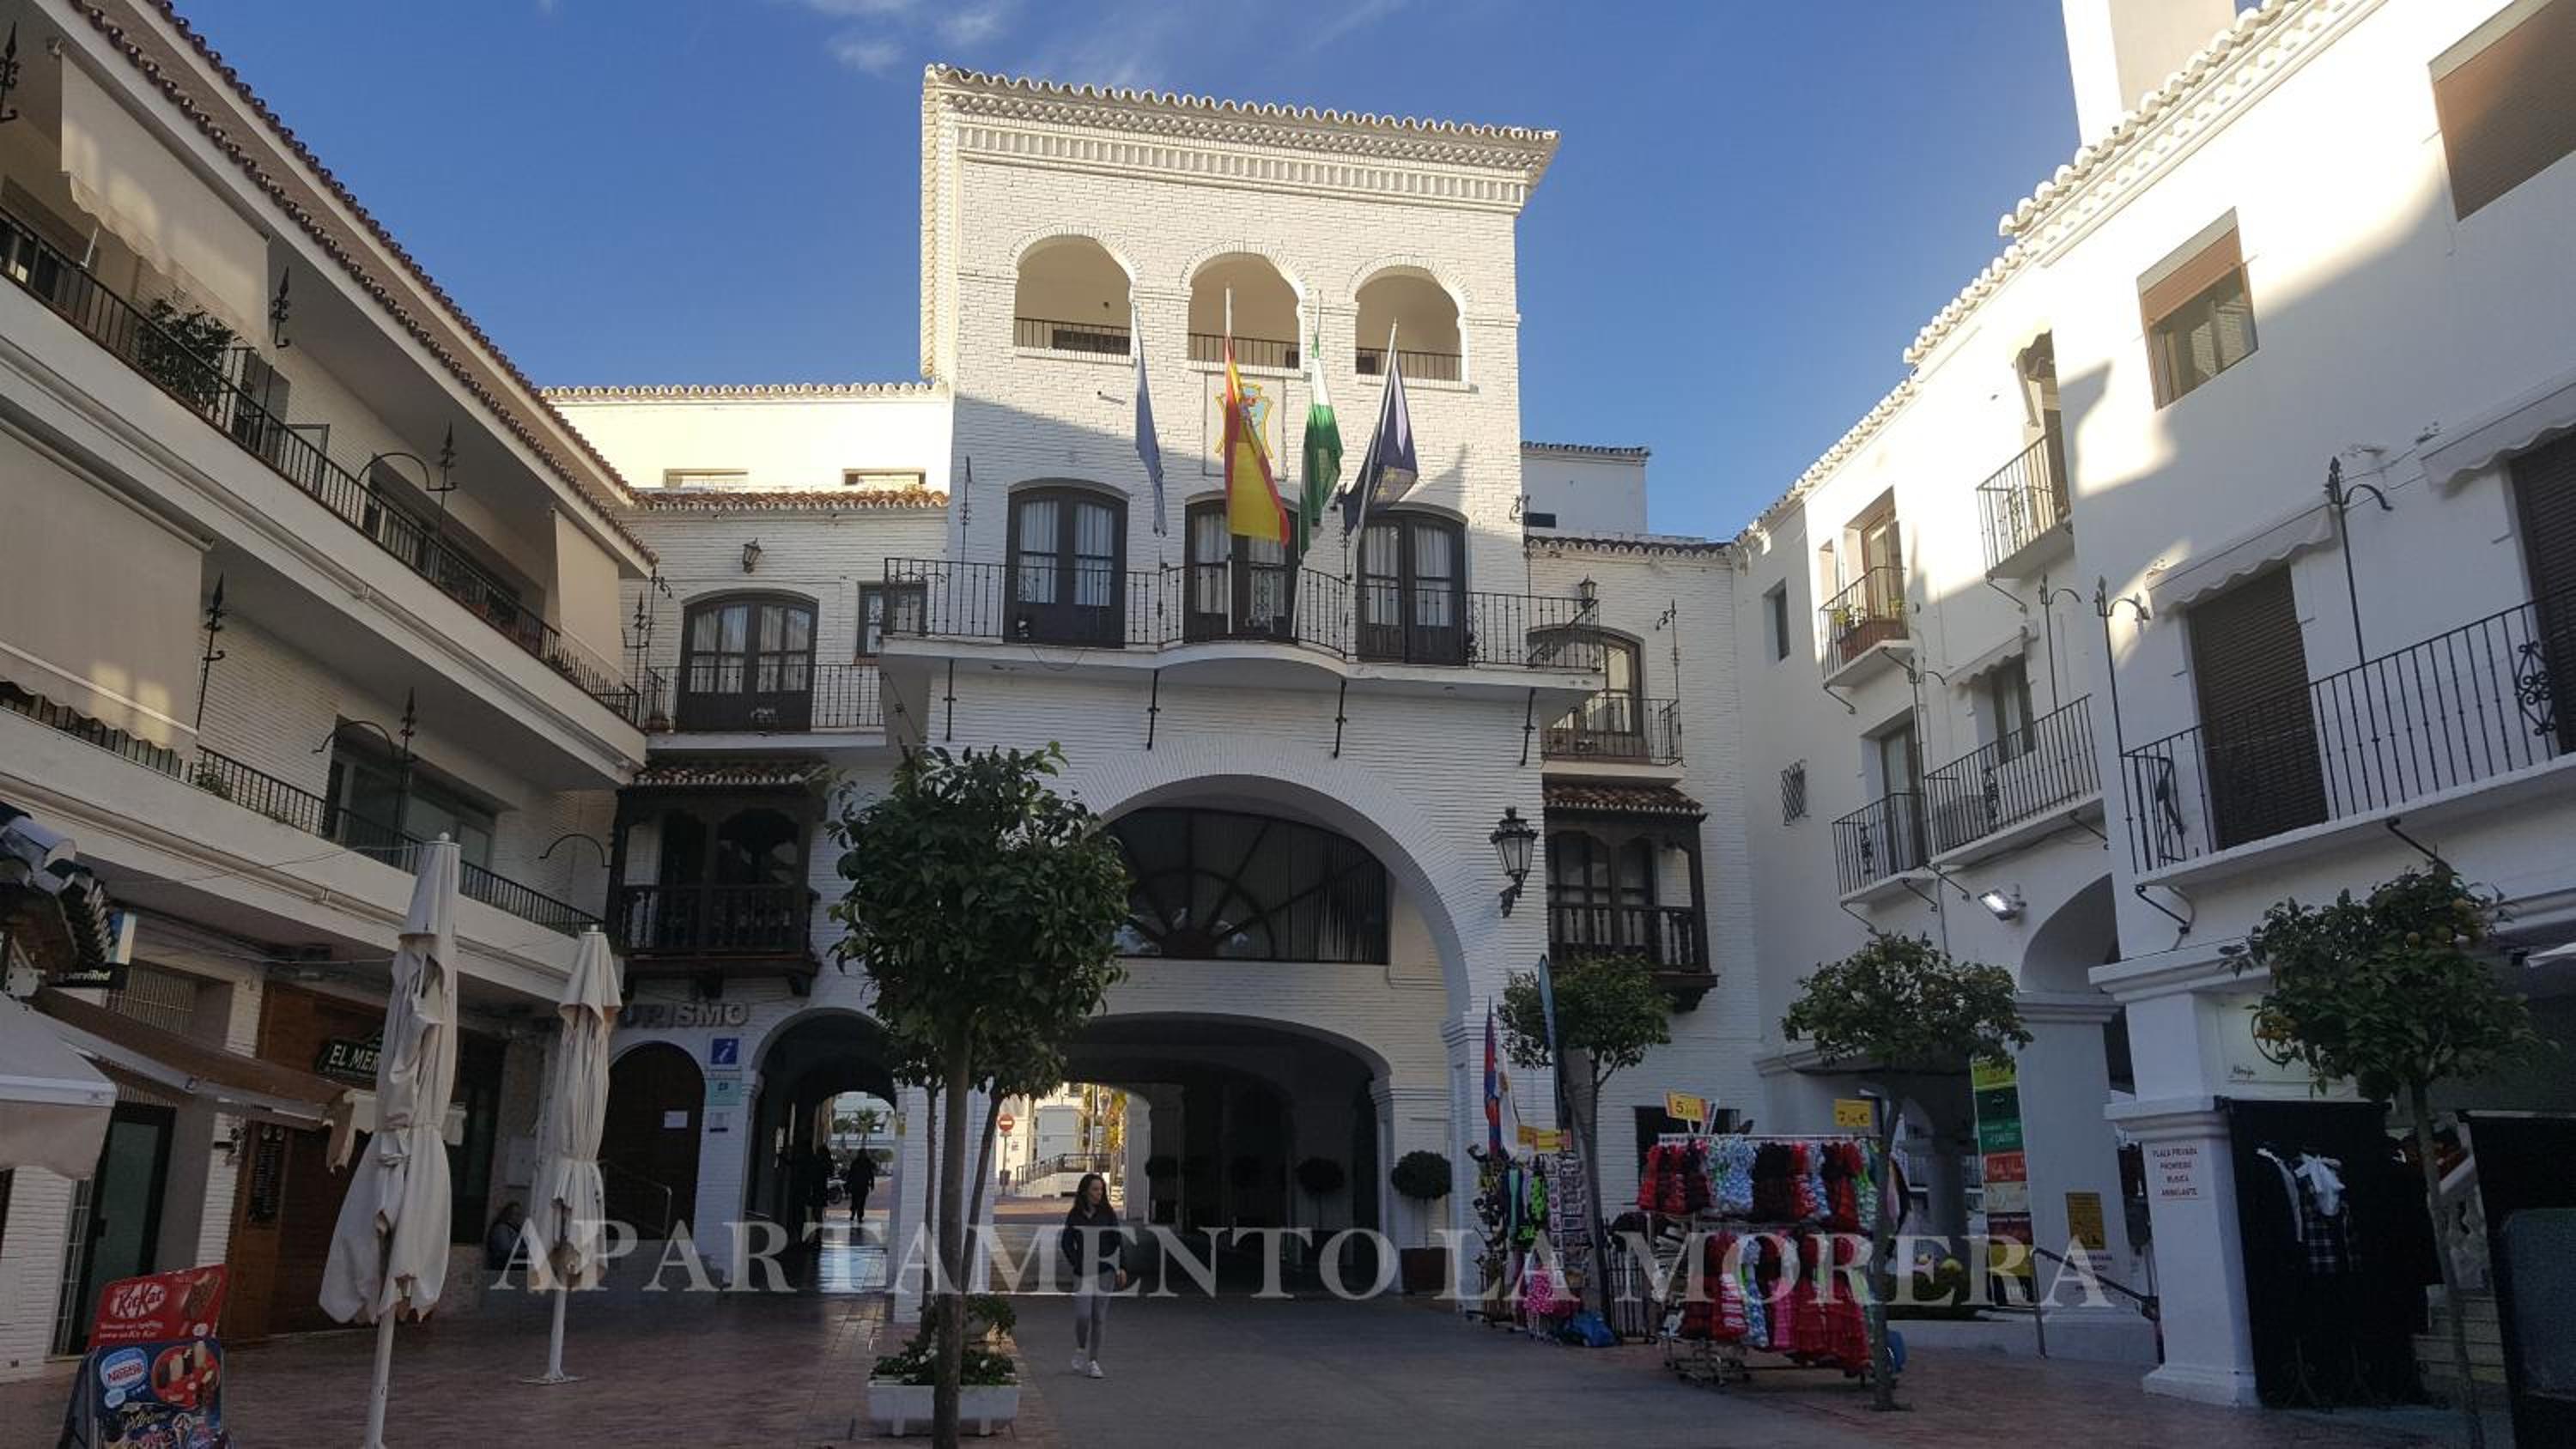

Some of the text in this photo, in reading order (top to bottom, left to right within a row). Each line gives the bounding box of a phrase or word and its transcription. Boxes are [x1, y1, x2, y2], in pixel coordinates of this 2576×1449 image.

[620, 1003, 750, 1028] URISMO
[329, 1044, 382, 1072] EL MER
